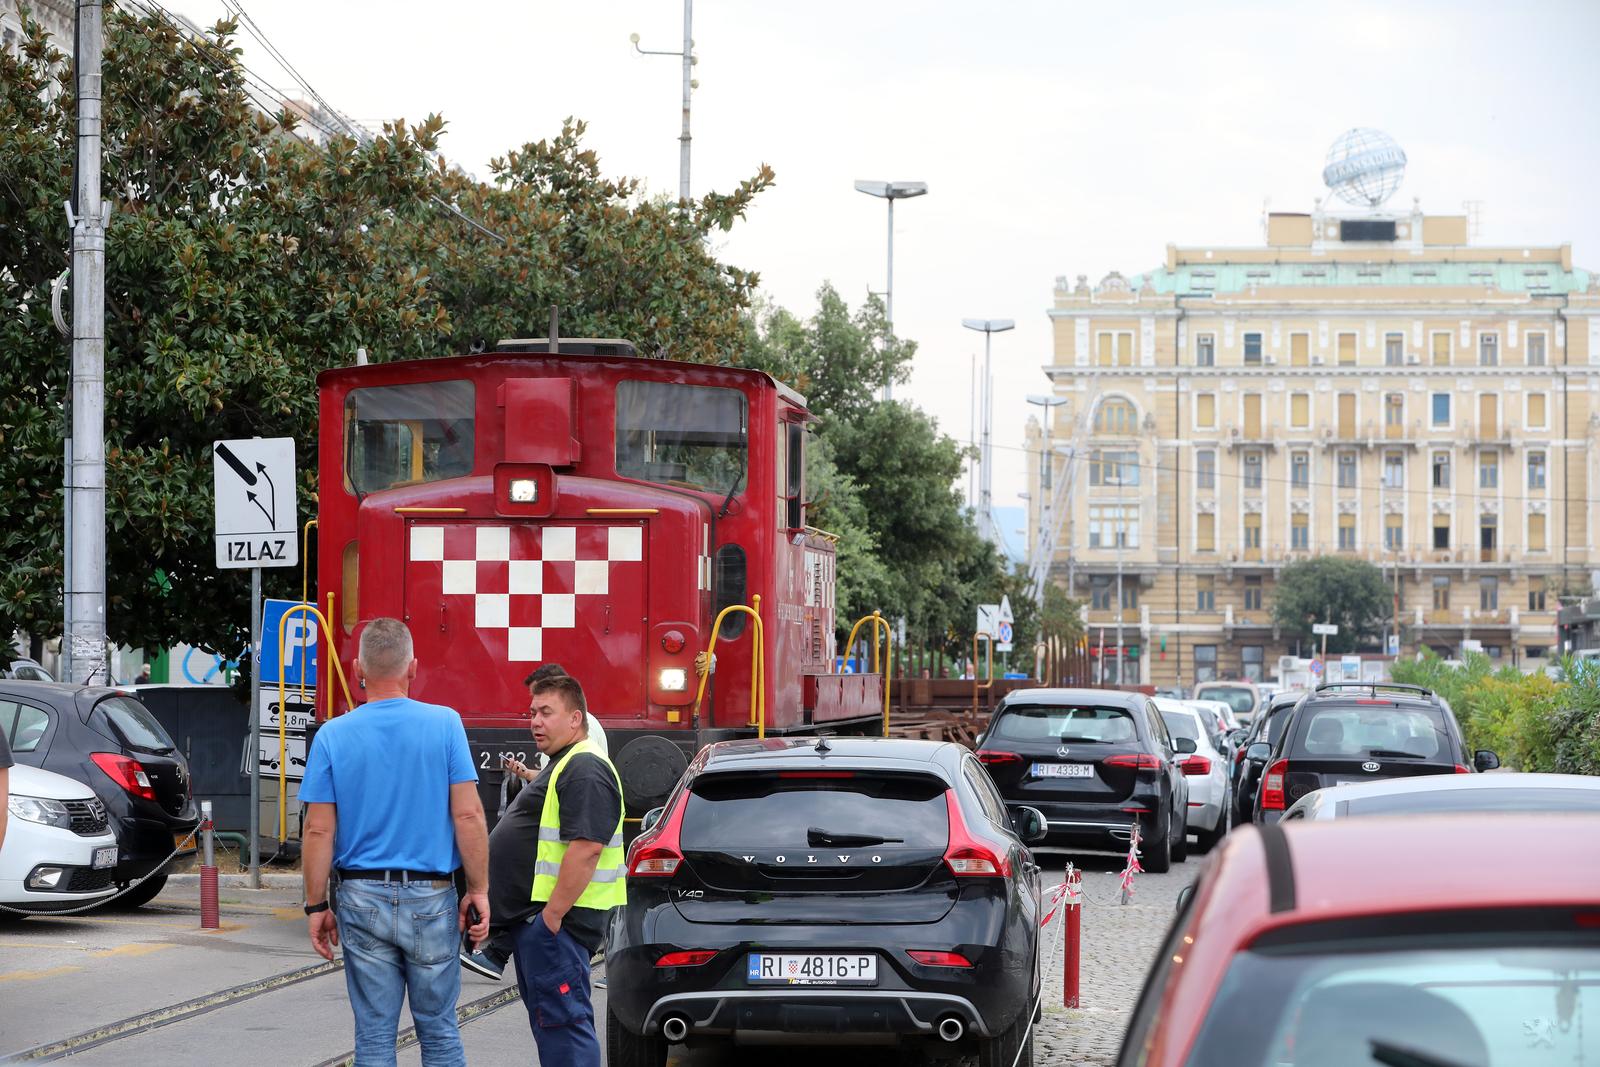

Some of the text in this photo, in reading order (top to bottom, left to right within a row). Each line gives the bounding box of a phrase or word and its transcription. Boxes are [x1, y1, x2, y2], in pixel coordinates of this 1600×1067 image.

[228, 540, 286, 561] IZLAZ
[1039, 765, 1049, 775] RI
[743, 855, 882, 863] VOLVO
[677, 889, 704, 898] V40
[762, 957, 870, 977] RI 4816-P
